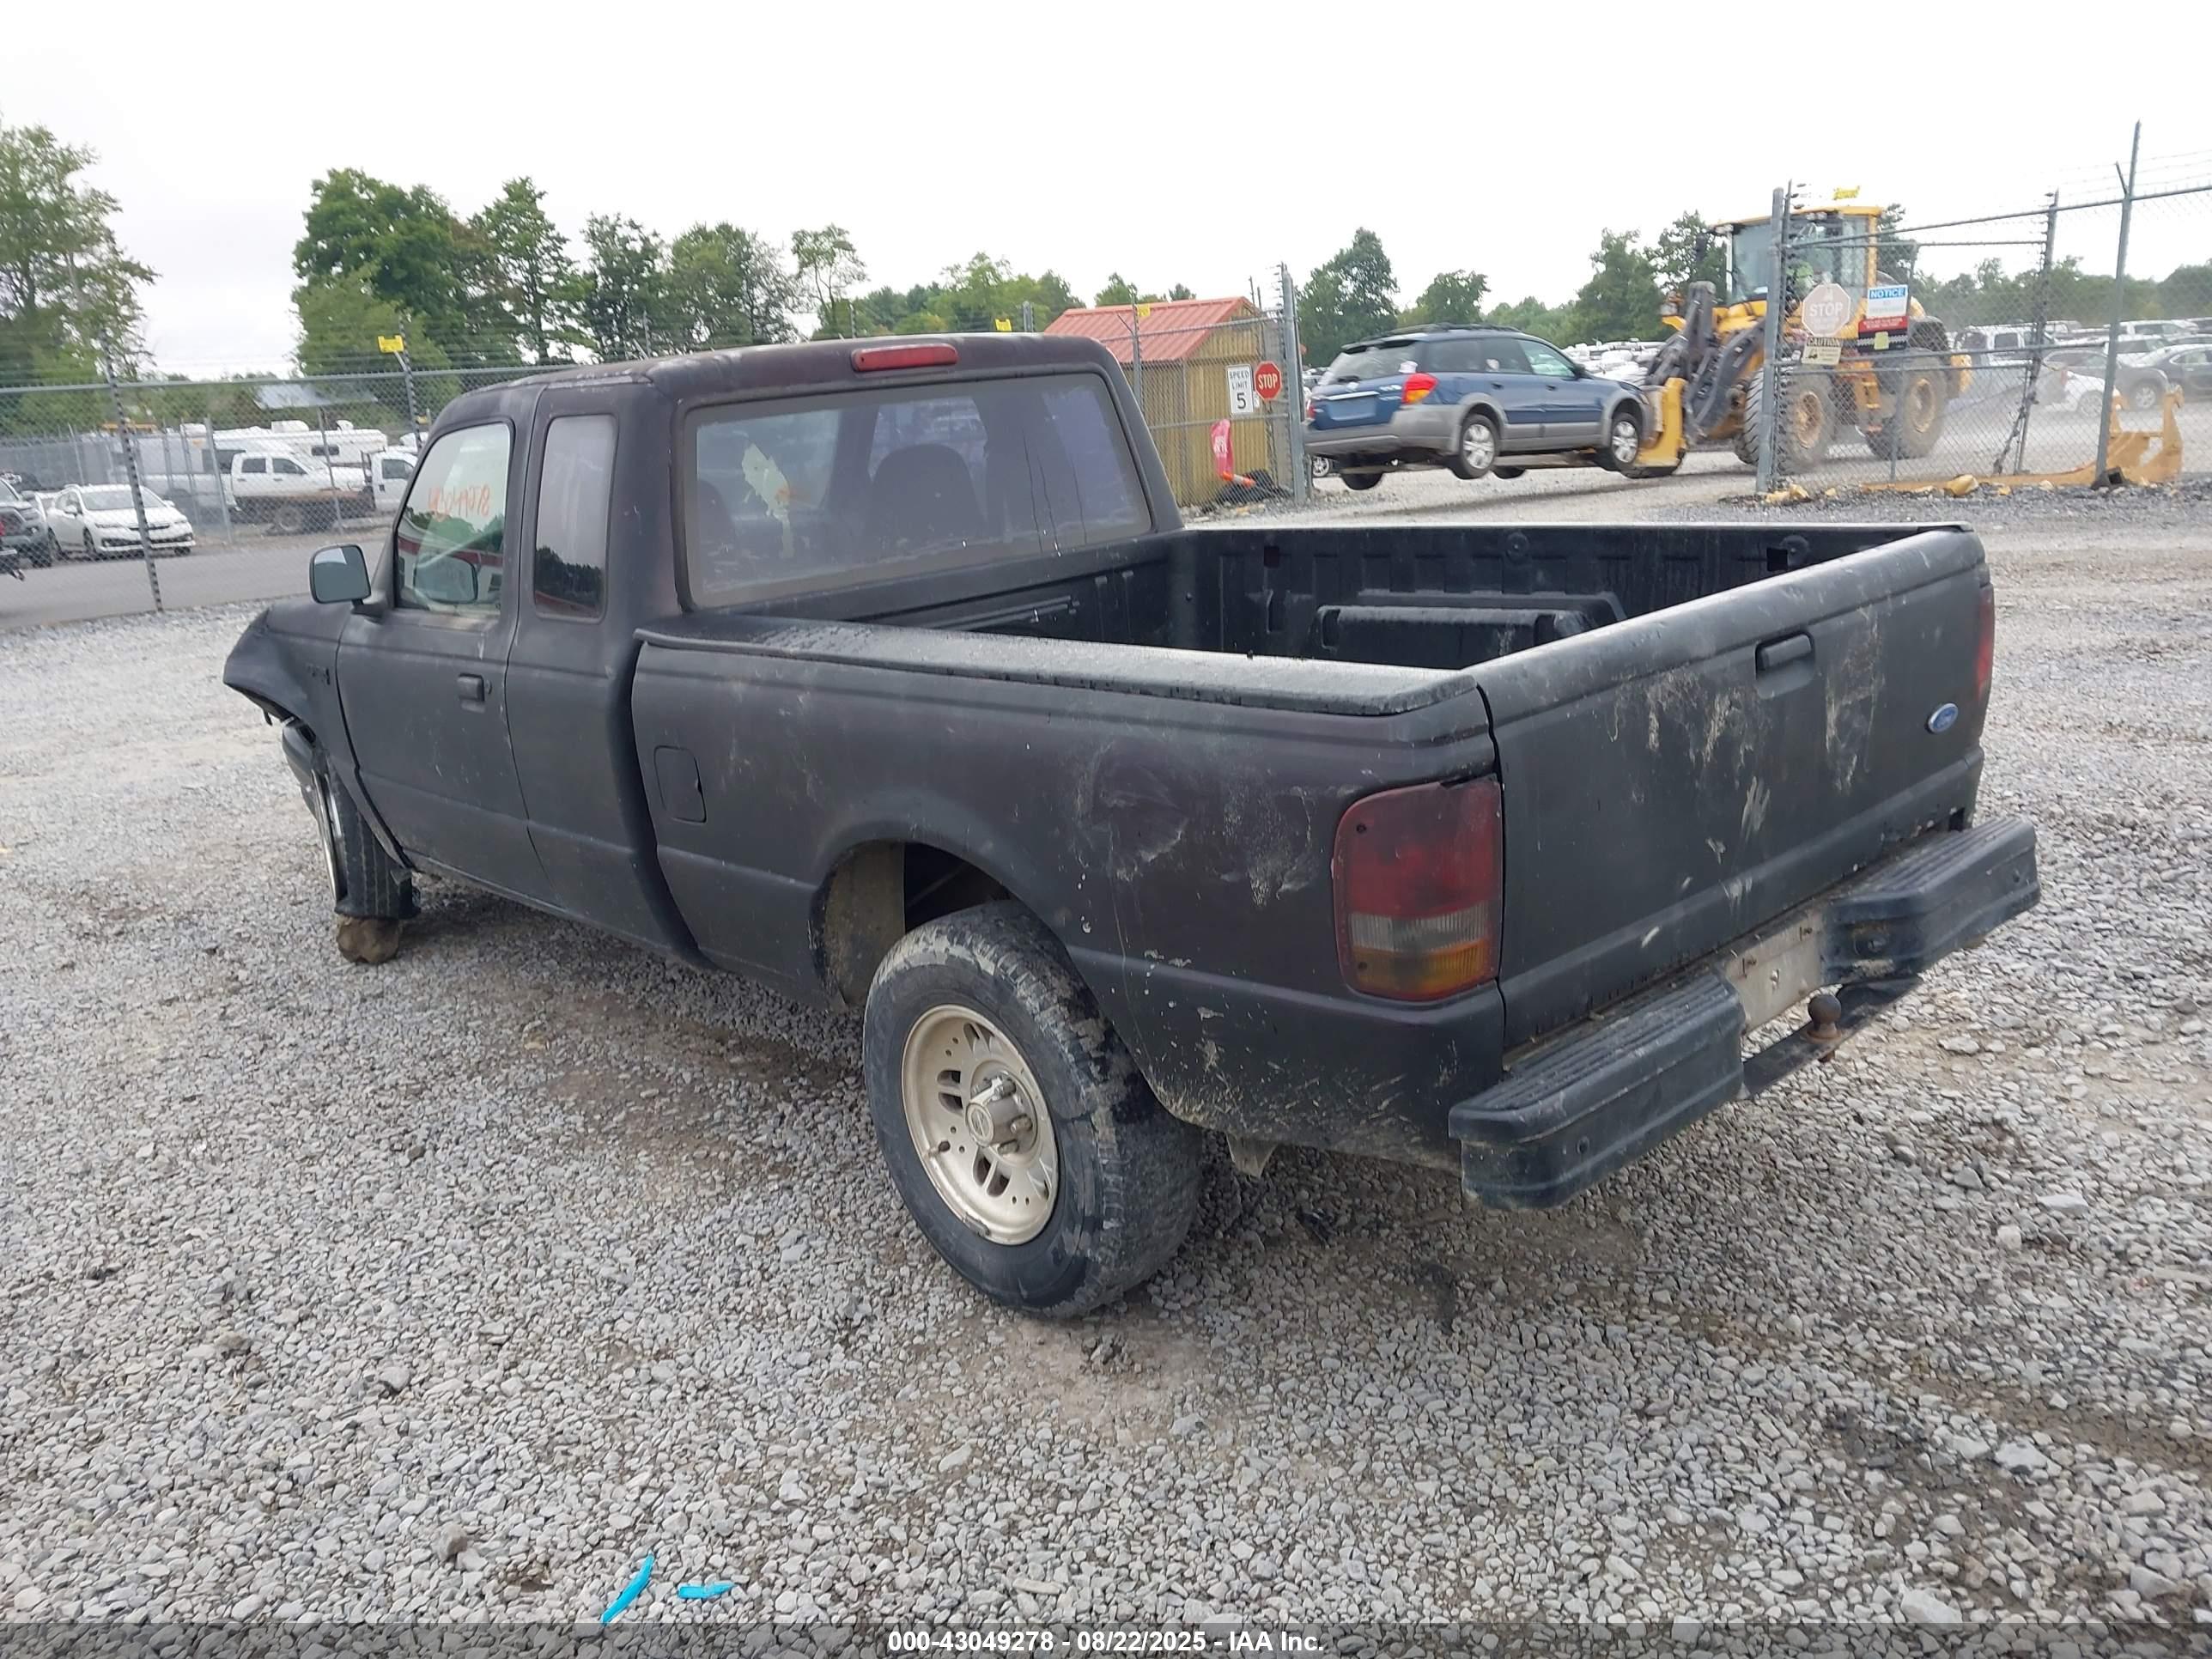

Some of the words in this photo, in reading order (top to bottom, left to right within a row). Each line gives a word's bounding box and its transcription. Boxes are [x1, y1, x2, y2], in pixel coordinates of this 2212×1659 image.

[1870, 288, 1905, 299] NOTICE
[1809, 302, 1843, 317] STOP
[1229, 370, 1249, 379] SPEED
[1231, 380, 1248, 390] LIMIT
[1258, 373, 1278, 390] STOP
[1237, 392, 1246, 409] 5
